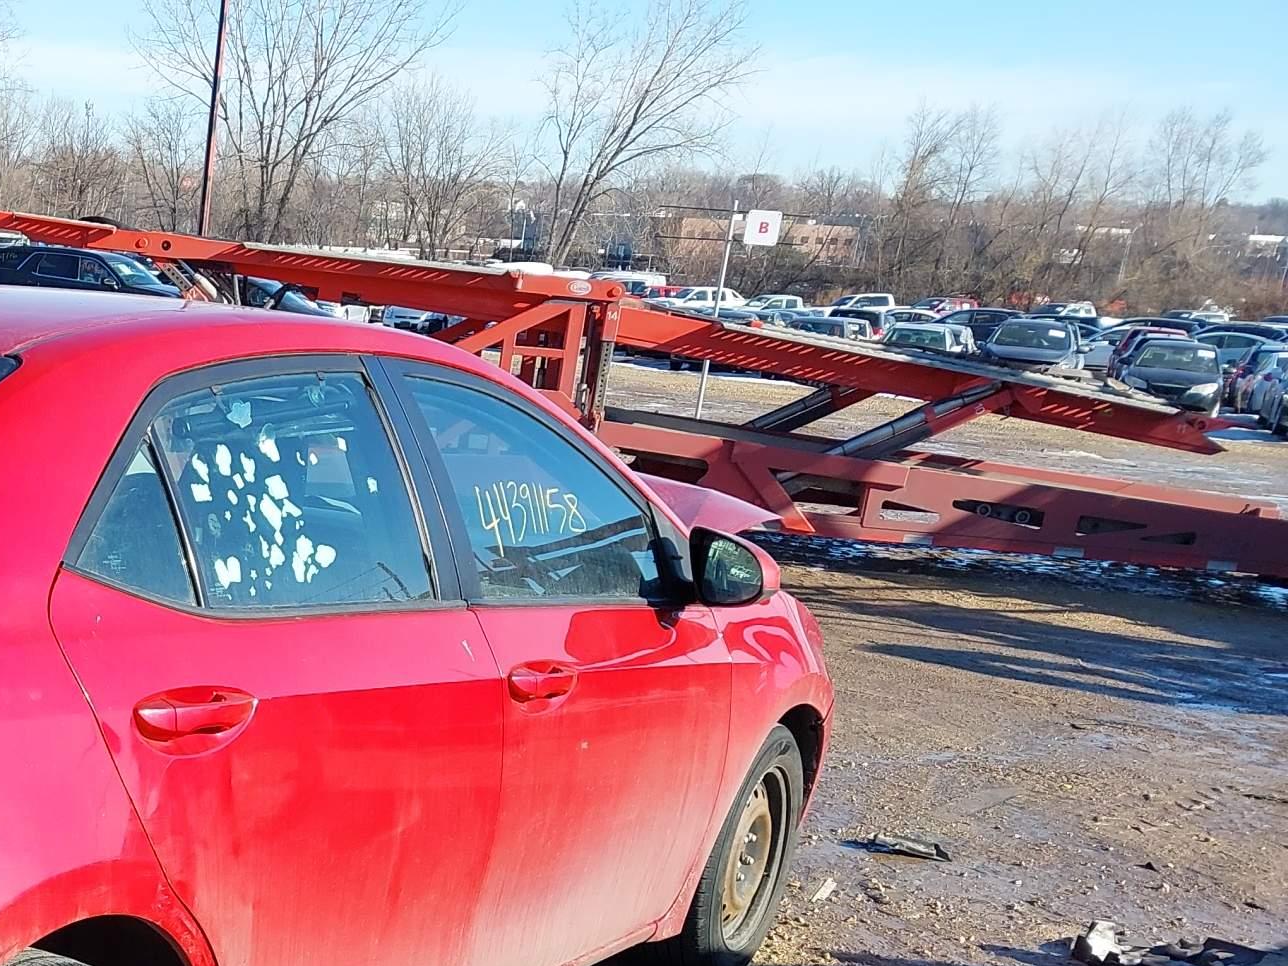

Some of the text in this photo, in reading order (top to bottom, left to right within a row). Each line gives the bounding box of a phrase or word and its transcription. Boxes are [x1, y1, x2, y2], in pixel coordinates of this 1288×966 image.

[758, 221, 769, 233] B
[607, 311, 618, 320] 14
[474, 481, 587, 557] 44391158
